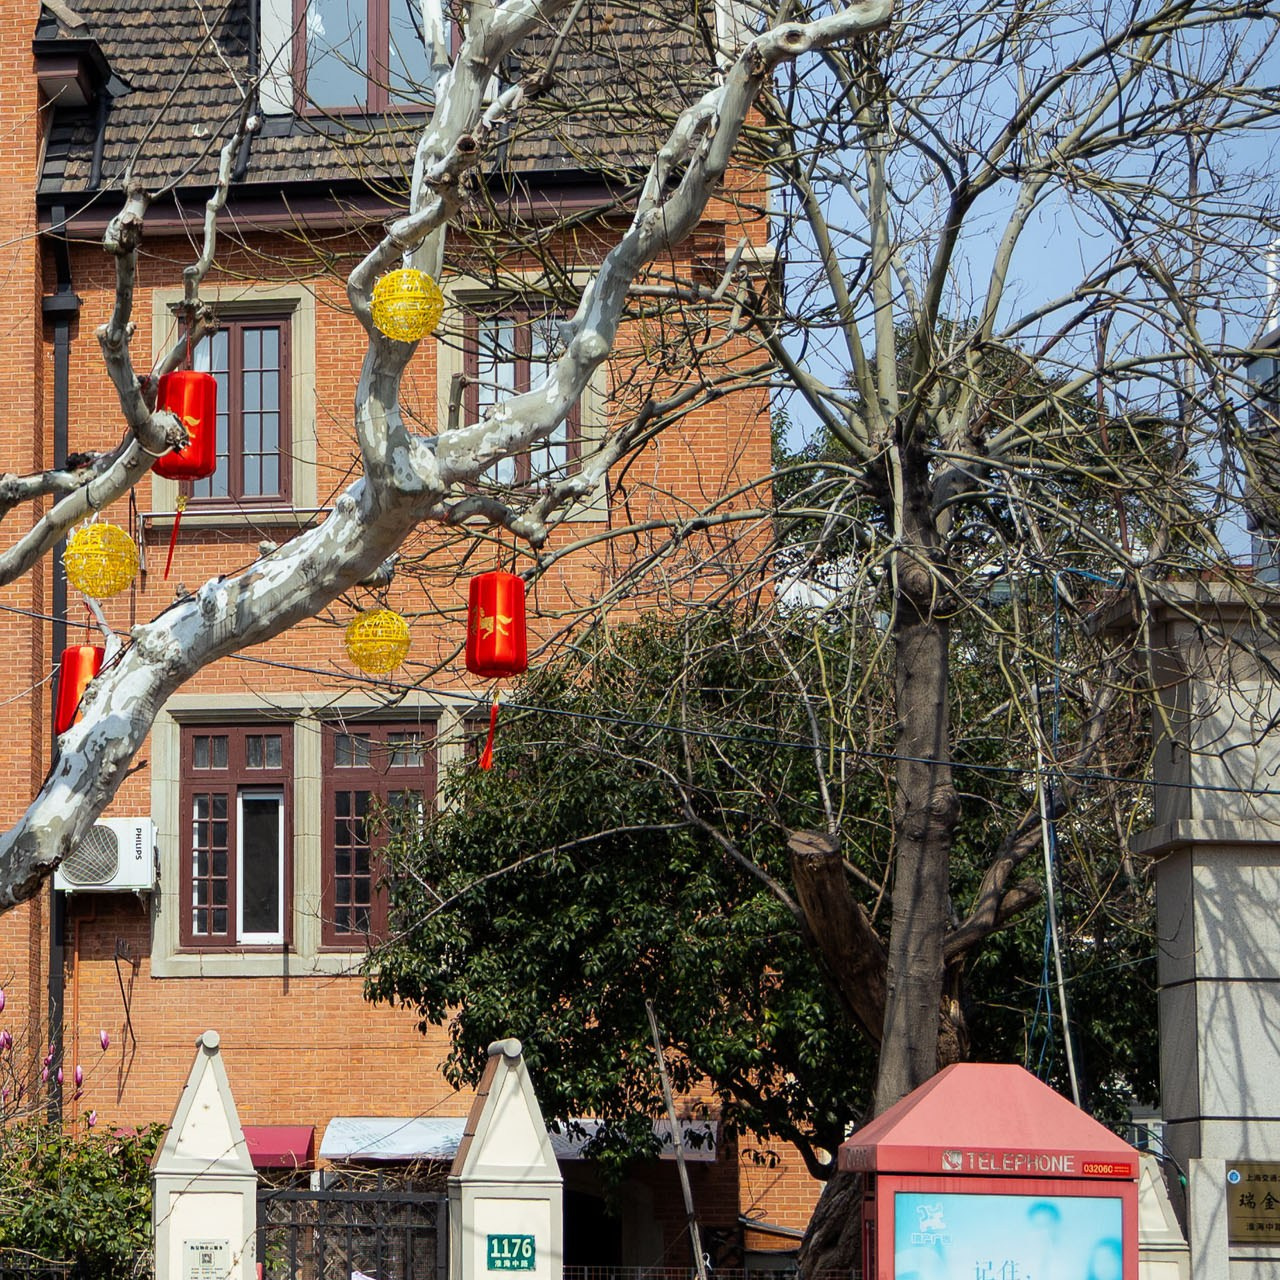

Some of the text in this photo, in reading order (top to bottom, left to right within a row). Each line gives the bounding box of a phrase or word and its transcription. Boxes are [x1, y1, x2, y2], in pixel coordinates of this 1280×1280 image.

[966, 1151, 1075, 1173] TELEPHONE
[1239, 1191, 1280, 1210] 瑞金
[490, 1238, 532, 1258] 1176
[494, 1259, 528, 1268] 淮海中路
